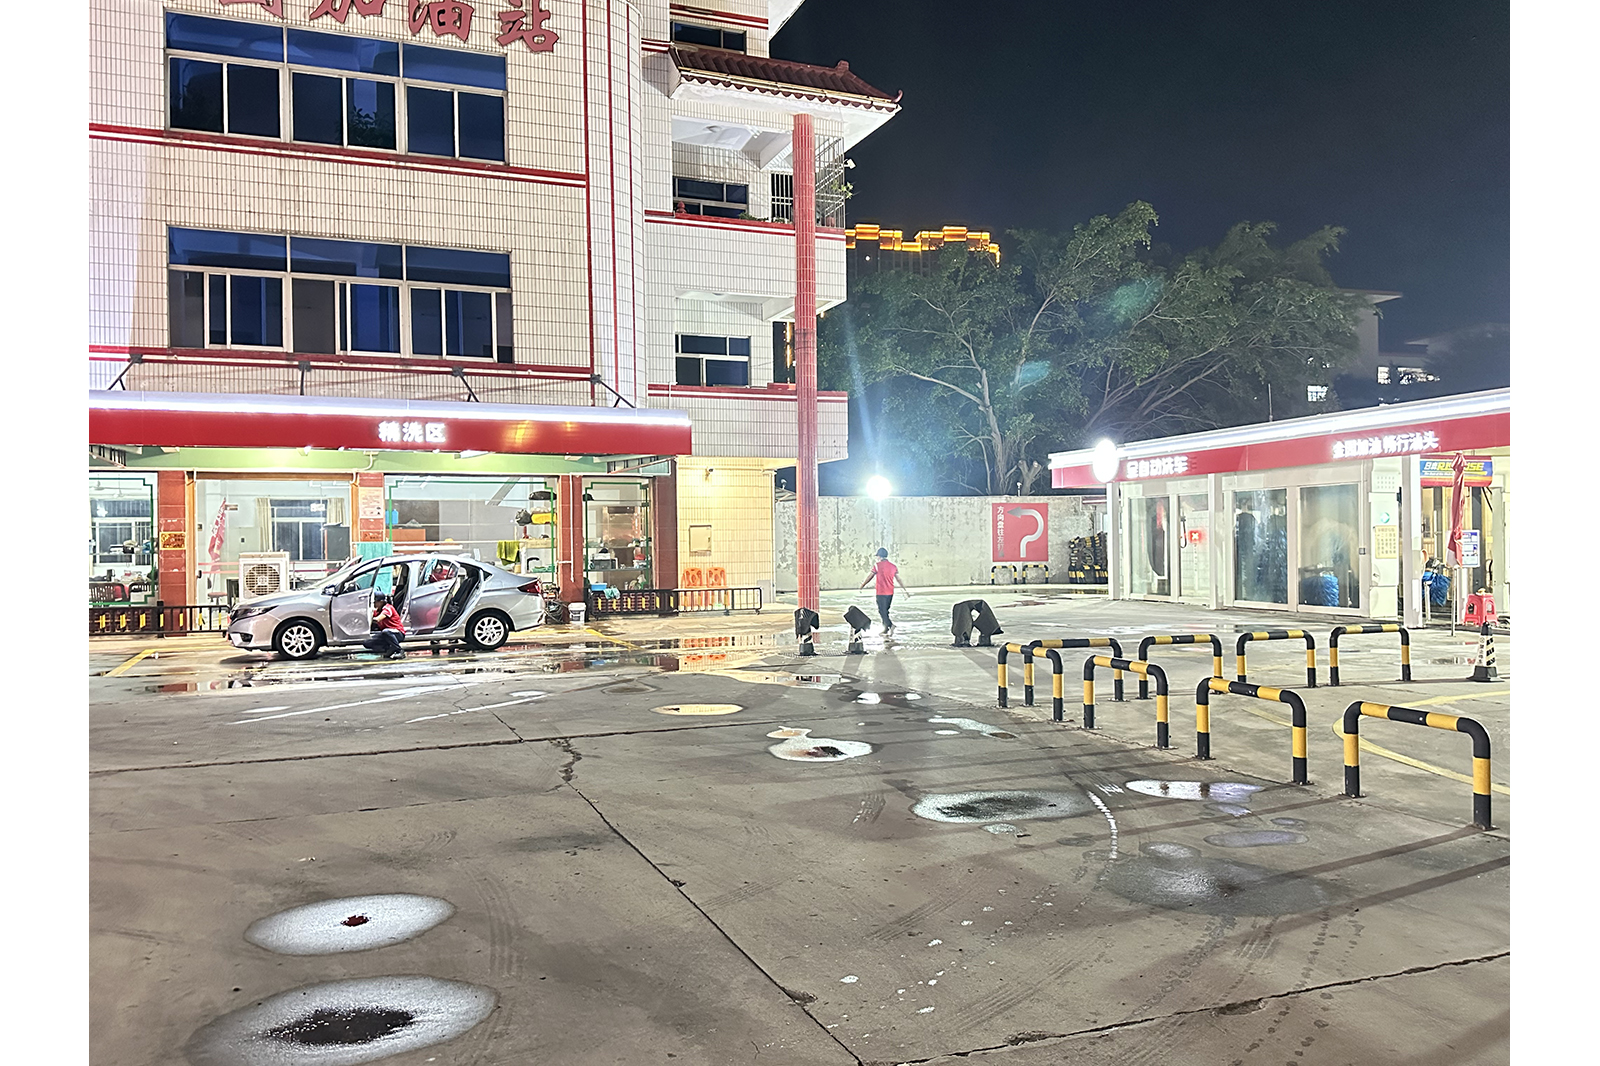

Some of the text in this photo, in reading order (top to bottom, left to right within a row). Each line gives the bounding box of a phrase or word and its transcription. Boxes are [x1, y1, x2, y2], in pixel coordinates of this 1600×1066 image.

[219, 0, 559, 54] 油站
[378, 420, 446, 443] 精洗区
[1126, 455, 1189, 479] 全自动洗车
